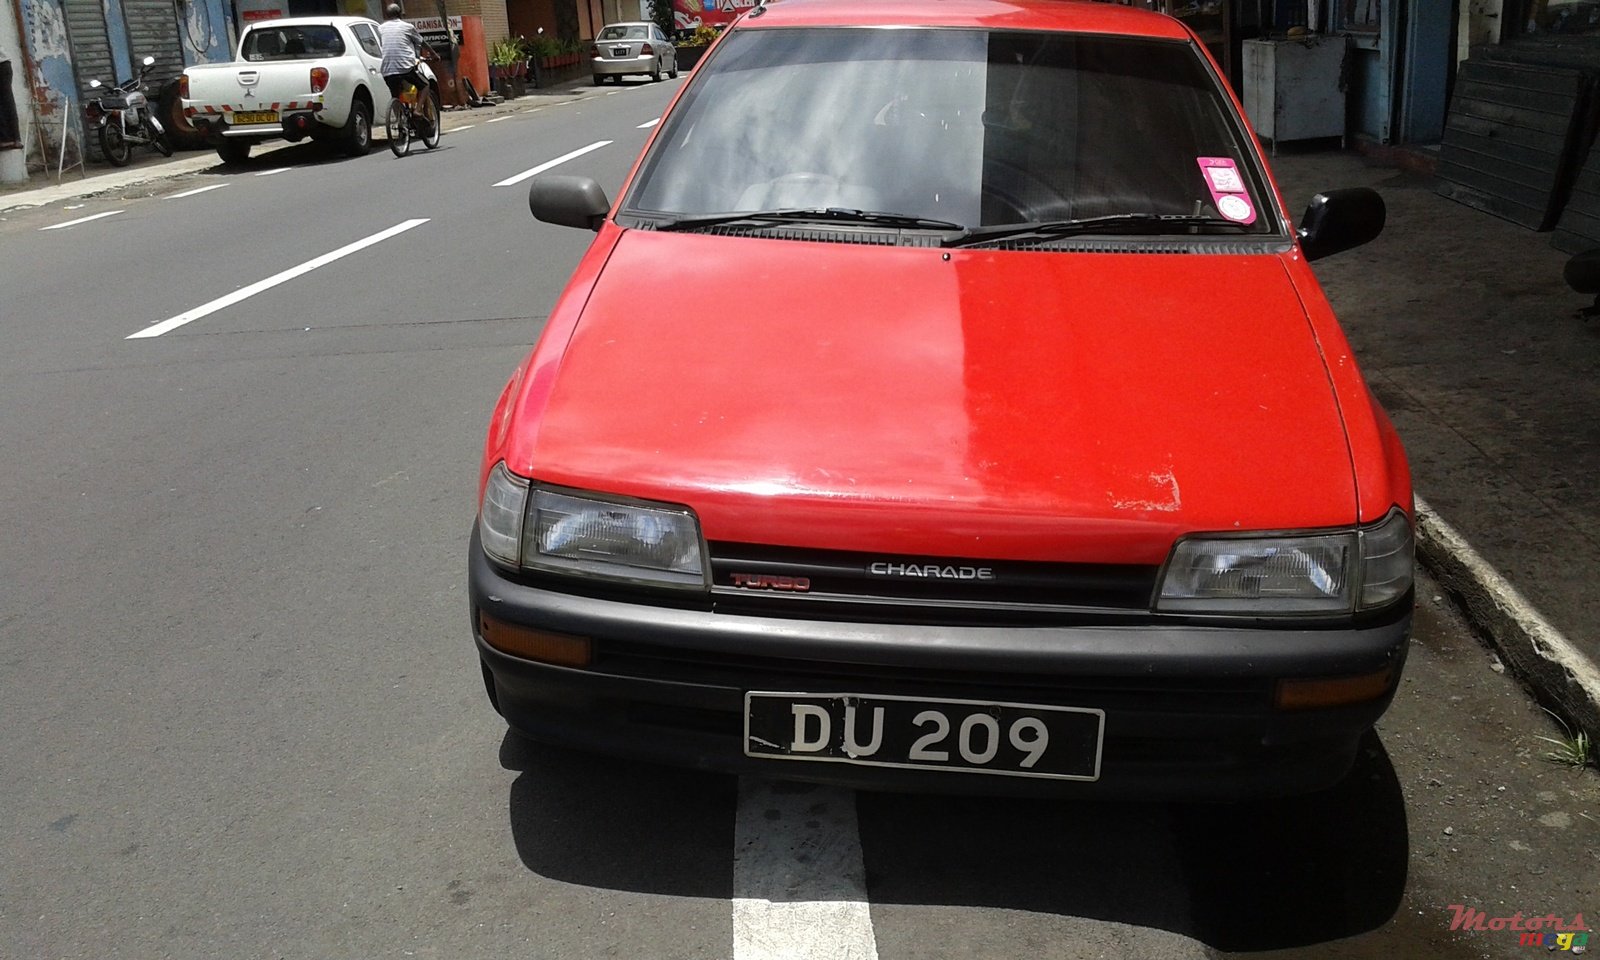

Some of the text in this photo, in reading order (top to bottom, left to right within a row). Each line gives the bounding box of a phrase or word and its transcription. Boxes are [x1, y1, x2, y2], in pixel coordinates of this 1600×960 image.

[870, 562, 993, 580] CHARADE
[730, 572, 811, 591] TURBO
[791, 703, 1050, 768] DU 209
